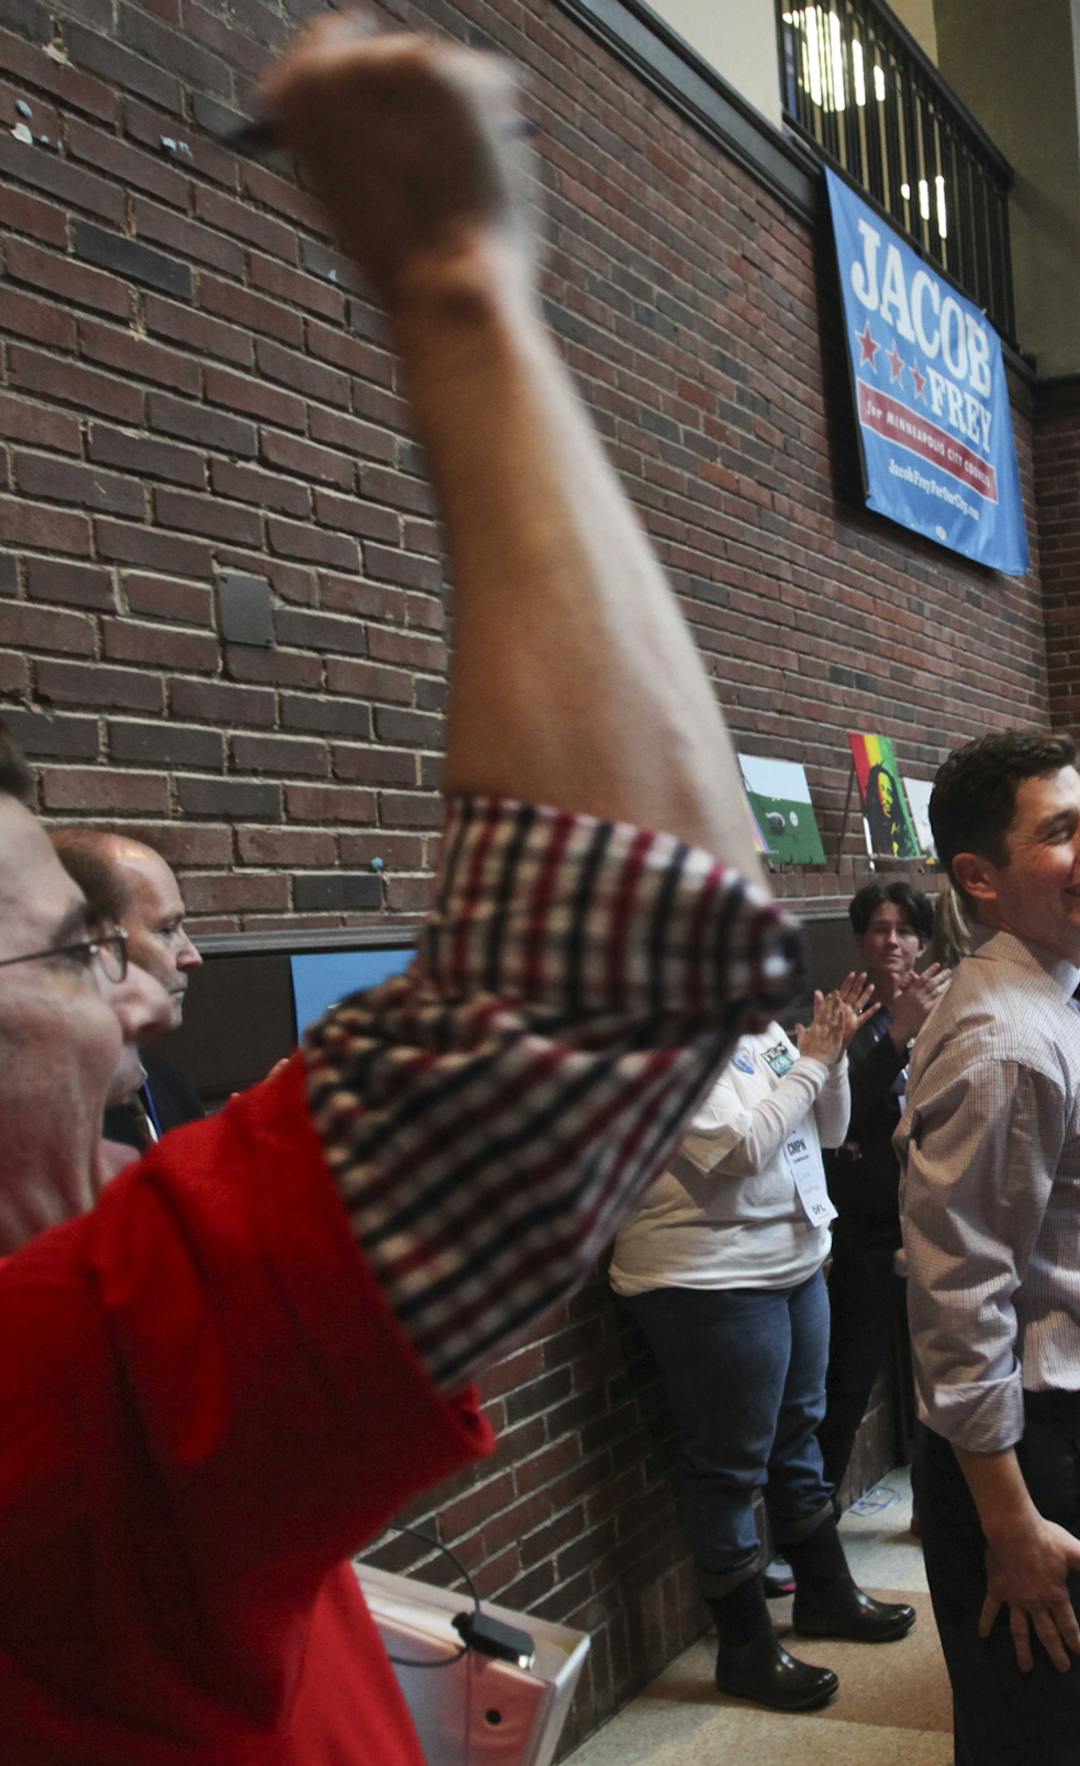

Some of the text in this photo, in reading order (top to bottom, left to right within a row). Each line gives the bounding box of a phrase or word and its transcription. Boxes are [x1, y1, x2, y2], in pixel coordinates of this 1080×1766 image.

[851, 218, 991, 398] JACOB
[867, 401, 883, 419] for
[886, 411, 946, 456] MINNEAPOLIS
[947, 448, 963, 467] CITY
[926, 365, 992, 454] FREY
